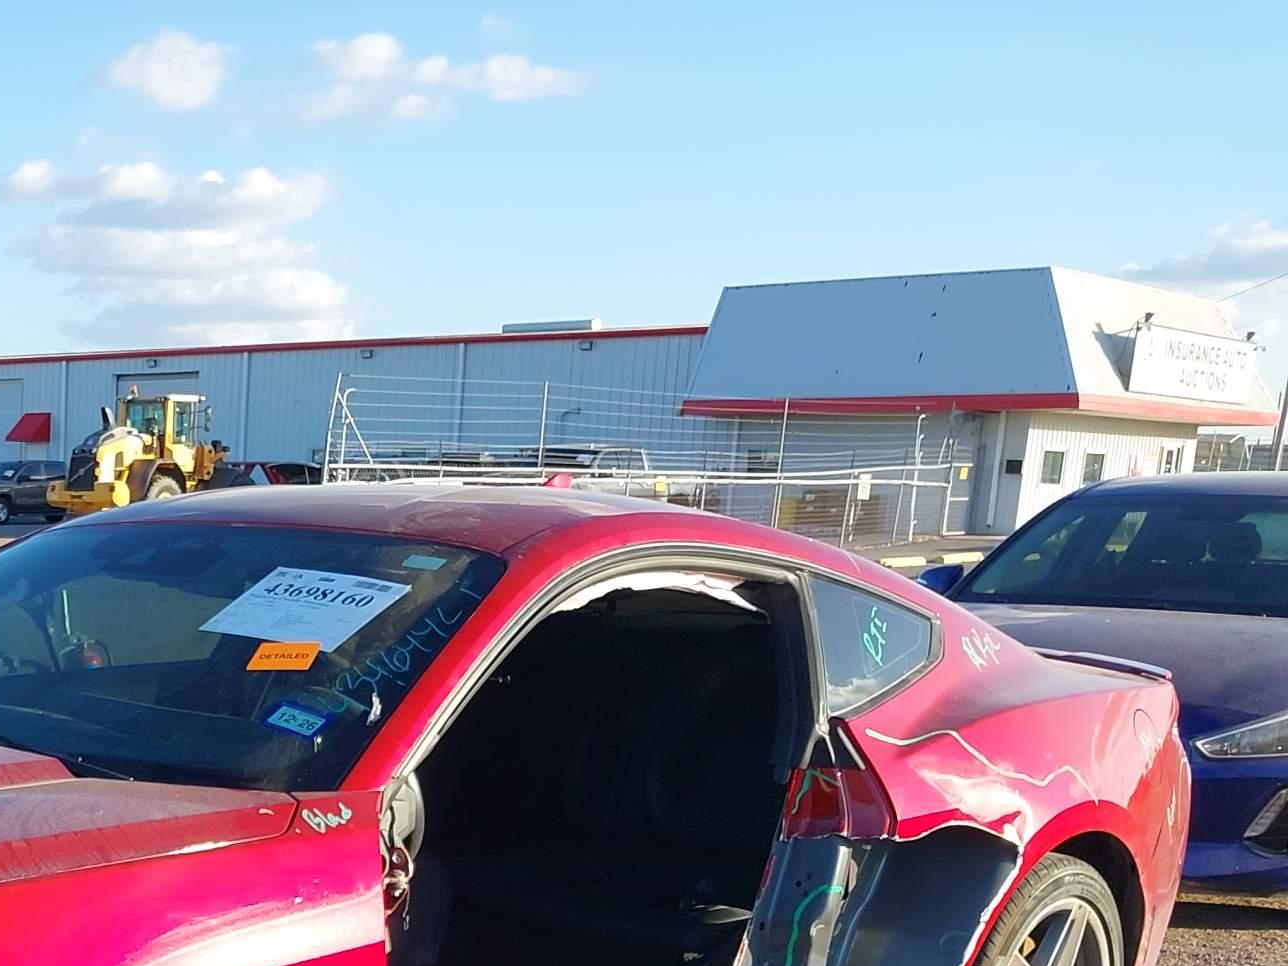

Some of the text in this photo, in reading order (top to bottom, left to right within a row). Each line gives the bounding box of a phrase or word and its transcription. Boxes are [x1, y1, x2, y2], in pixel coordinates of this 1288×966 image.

[1165, 339, 1222, 365] INSURANCE
[1223, 350, 1248, 370] AUTO
[1179, 368, 1227, 391] AUCTIONS
[264, 582, 375, 608] 43698160
[258, 651, 310, 661] DETAILED
[277, 710, 318, 732] 12-26
